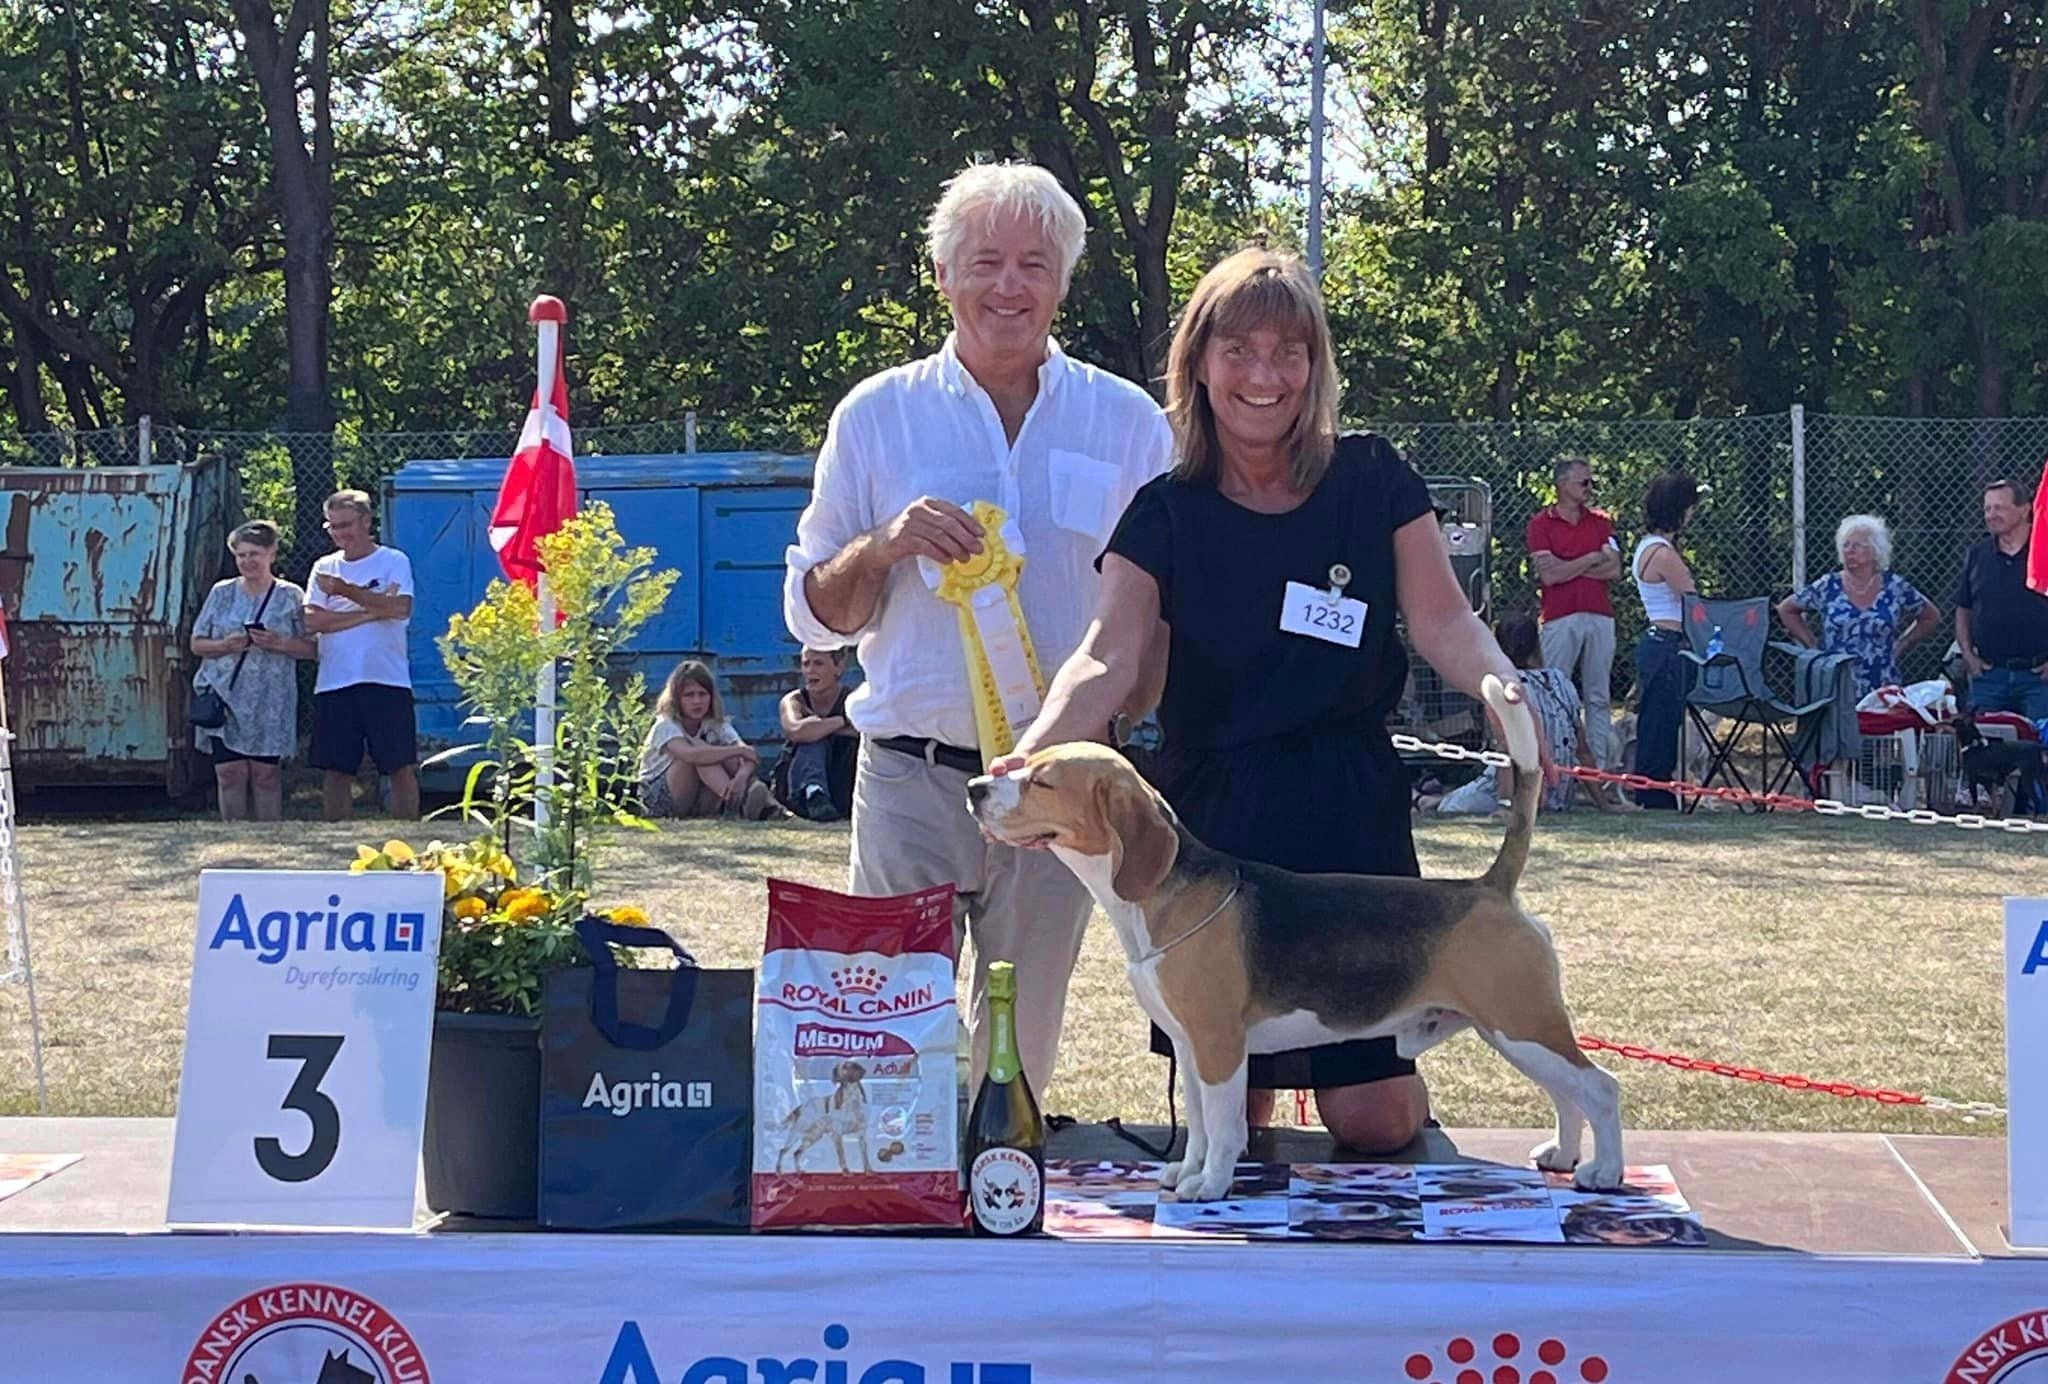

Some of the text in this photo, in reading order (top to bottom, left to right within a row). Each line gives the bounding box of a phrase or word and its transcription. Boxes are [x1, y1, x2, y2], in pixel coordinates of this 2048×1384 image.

[1304, 604, 1355, 634] 1232
[209, 894, 375, 964] Agria
[285, 966, 420, 991] Dyreforsikring
[782, 983, 933, 1015] ROYAL CANIN
[798, 1030, 884, 1050] MEDIUM
[873, 1061, 912, 1076] Adult
[254, 1034, 345, 1182] 3
[582, 1072, 684, 1116] Agria
[258, 1289, 377, 1334] KENNEL
